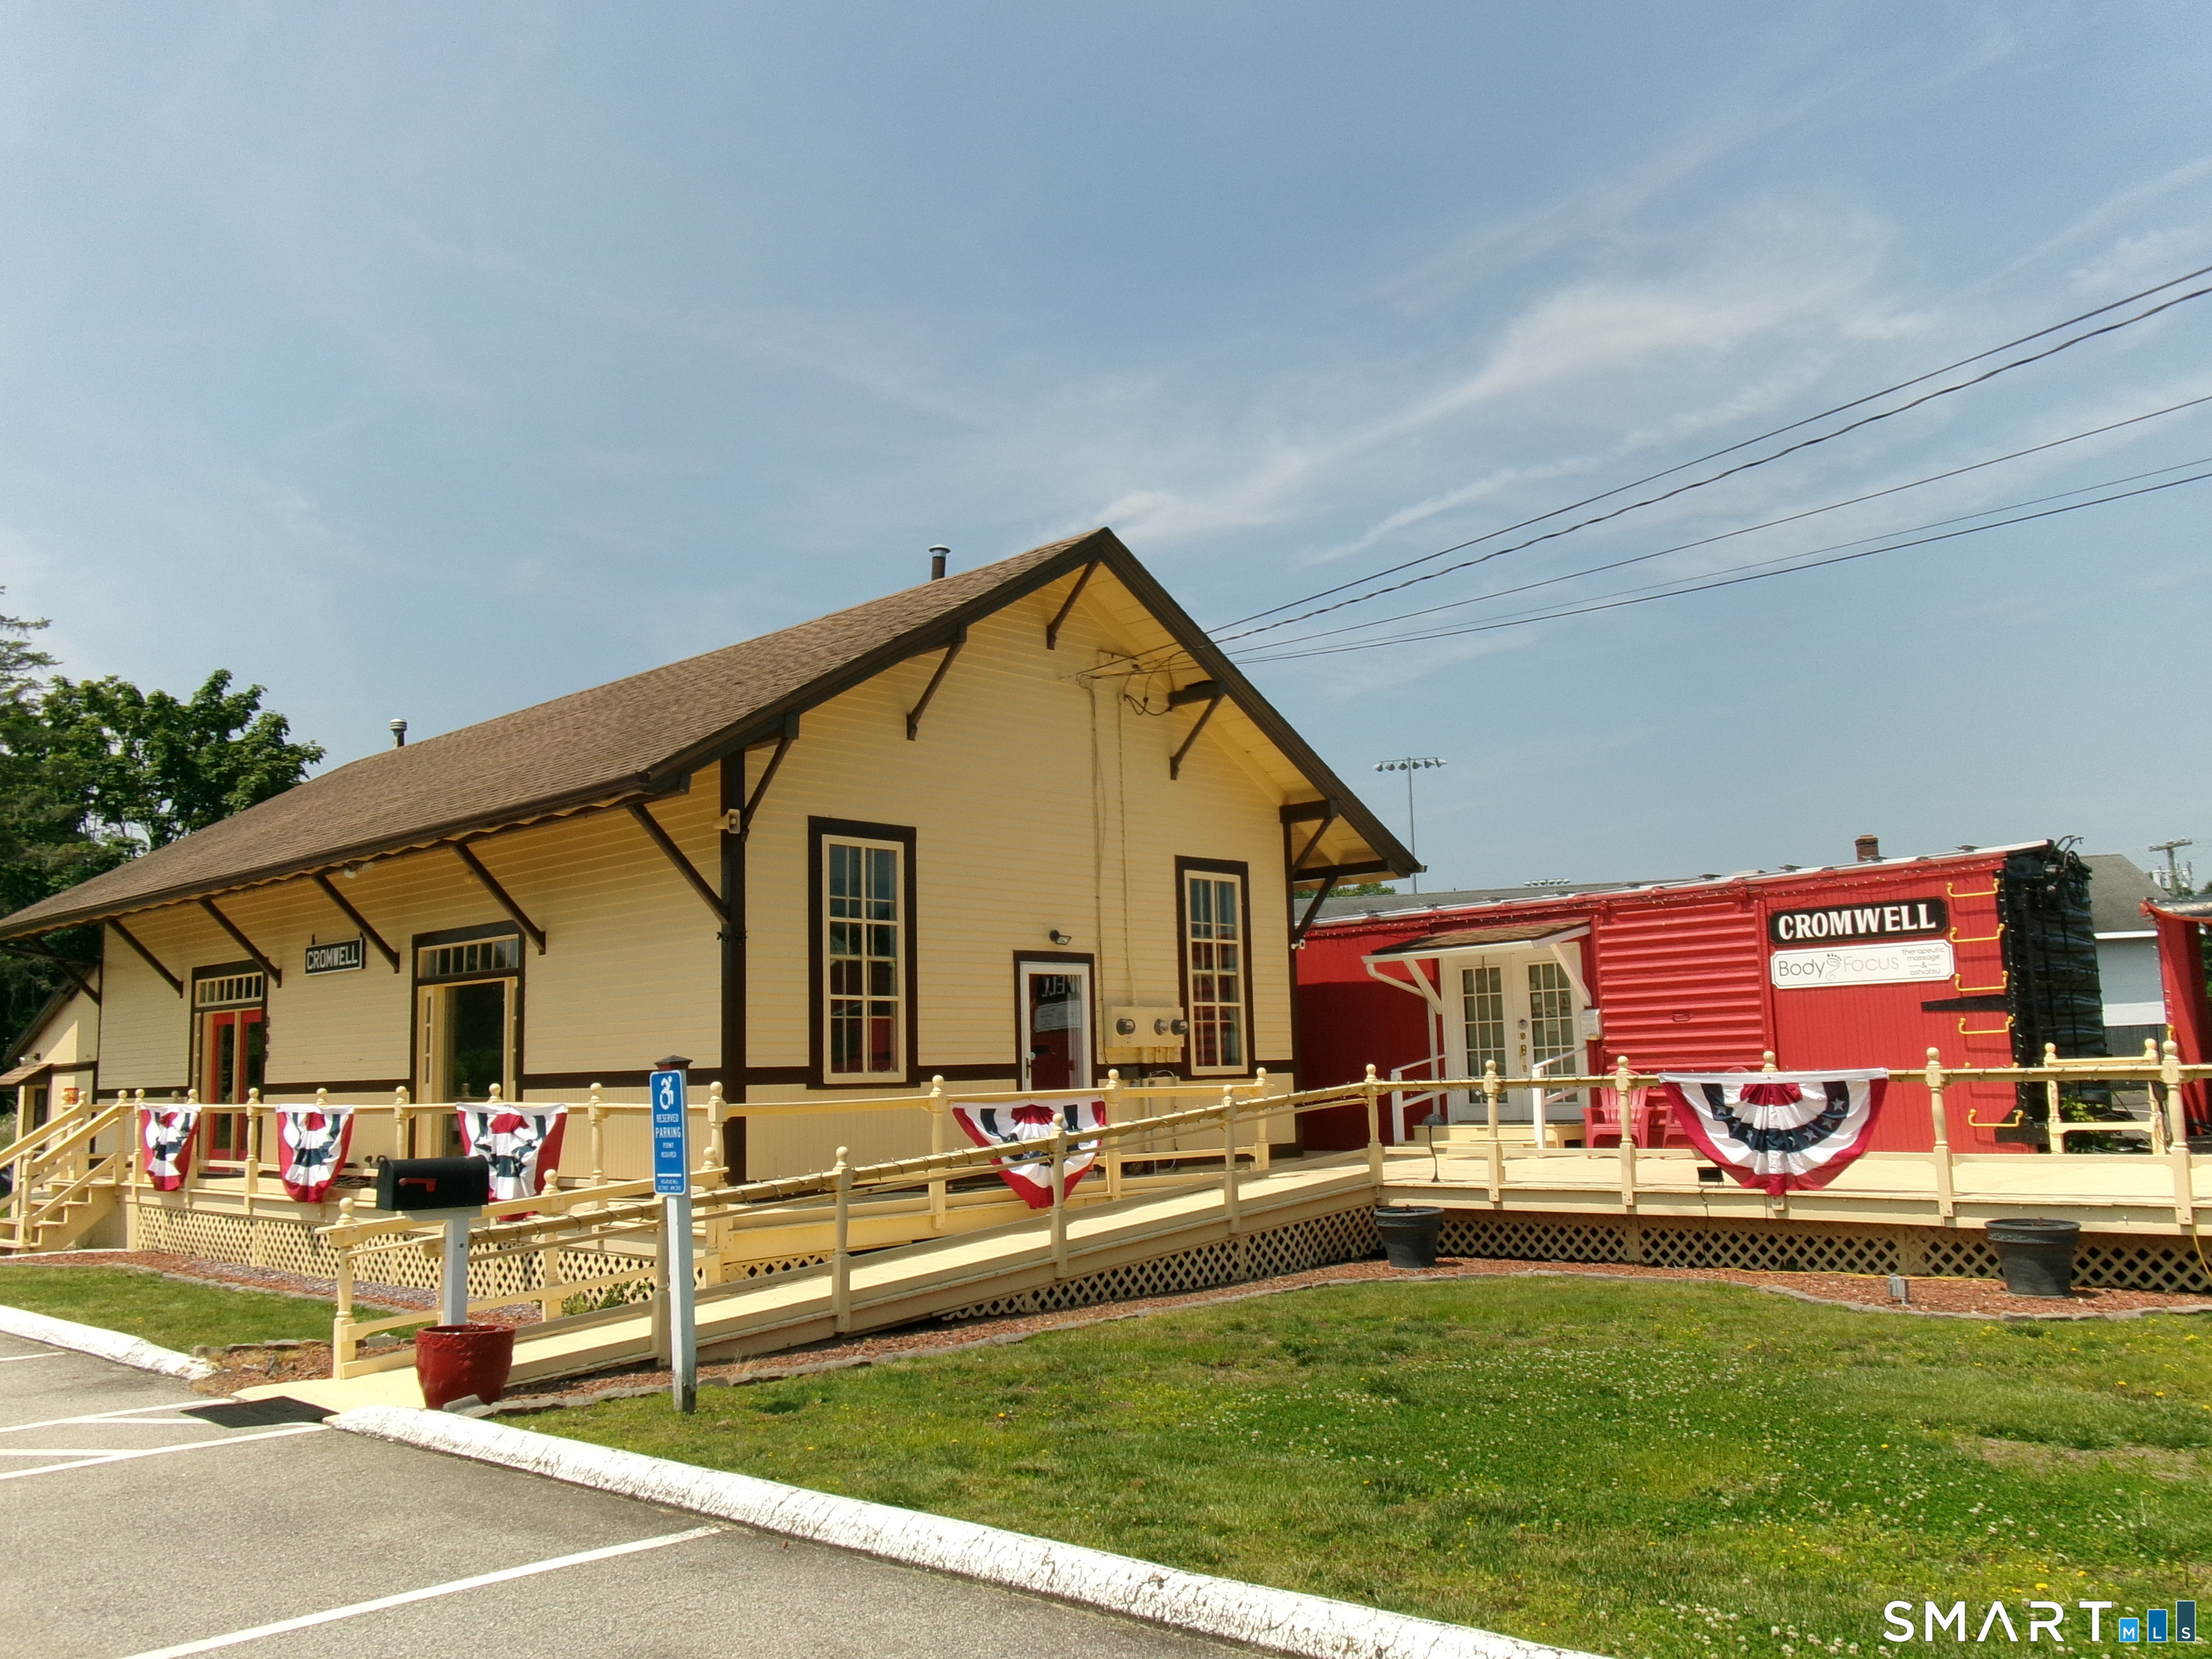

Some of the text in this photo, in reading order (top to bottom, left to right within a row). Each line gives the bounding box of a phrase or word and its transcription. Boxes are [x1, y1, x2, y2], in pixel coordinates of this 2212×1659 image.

[1778, 903, 1937, 940] CROMWELL
[306, 944, 359, 970] CROMWELL
[1902, 946, 1946, 956] therapeutic
[1778, 958, 1825, 979] Body
[656, 1113, 679, 1123] RESERVED
[655, 1126, 681, 1138] PARKING
